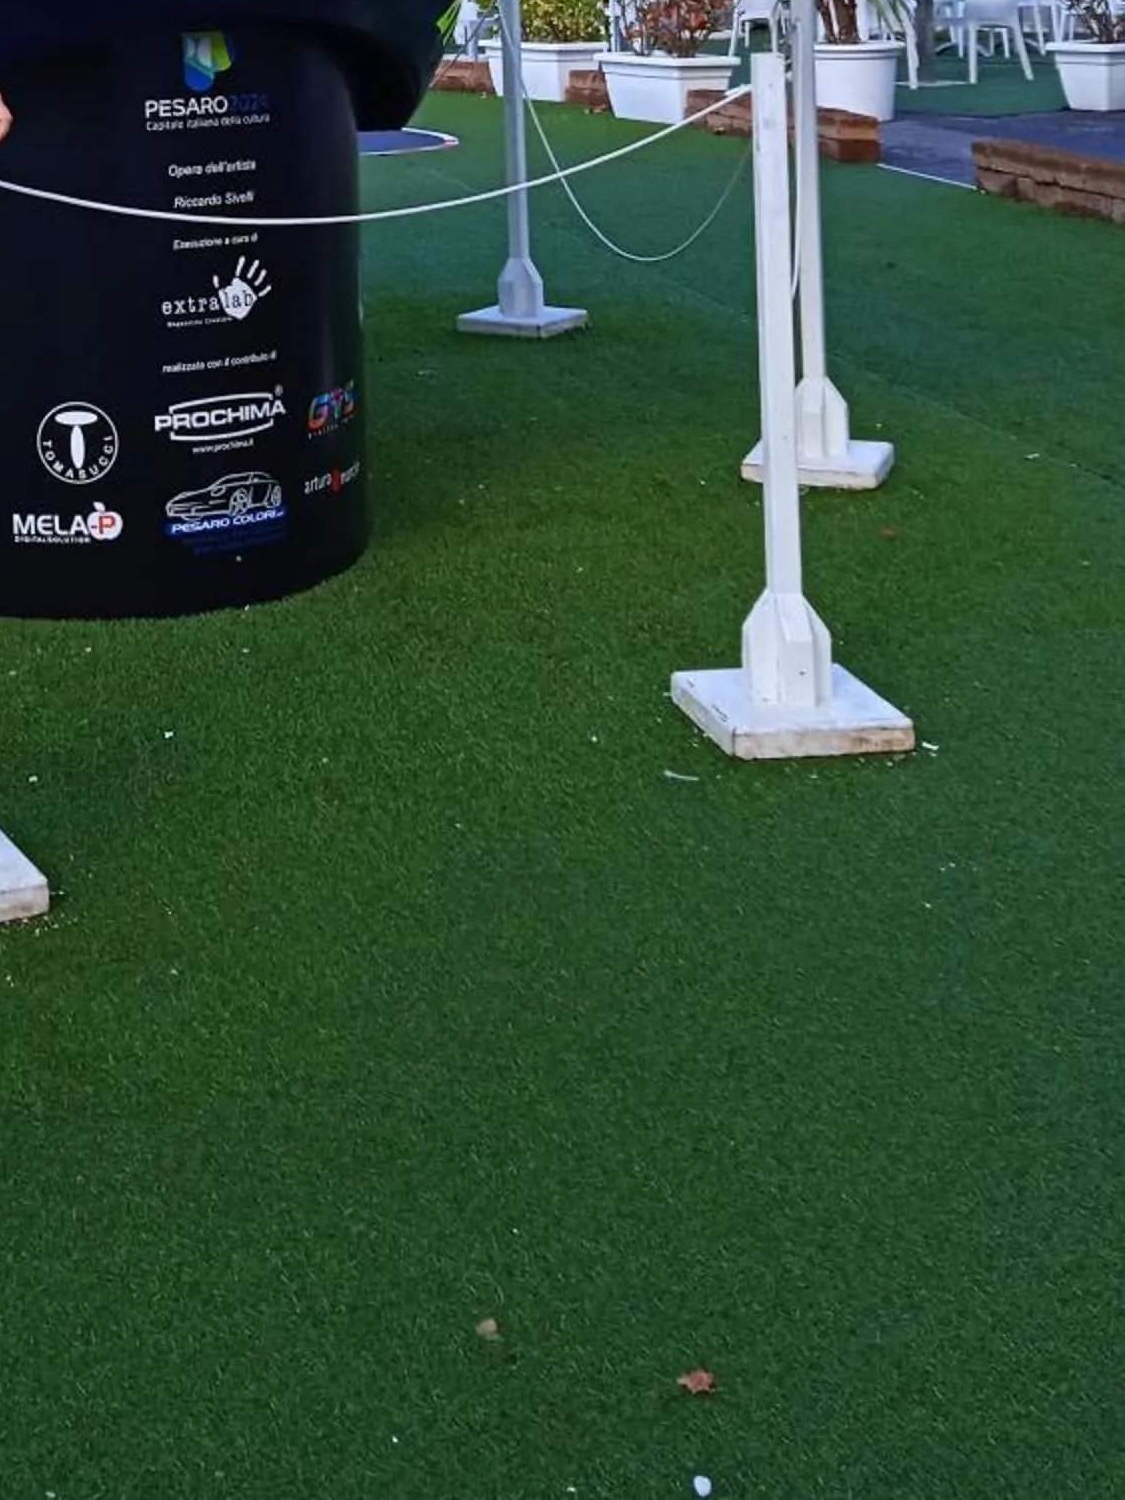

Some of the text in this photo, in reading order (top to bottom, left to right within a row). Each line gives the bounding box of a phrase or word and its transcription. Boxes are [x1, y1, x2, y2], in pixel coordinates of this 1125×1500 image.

[144, 96, 228, 118] PESARO
[146, 119, 184, 131] Capitale
[221, 115, 241, 127] della
[243, 113, 270, 125] cultura
[168, 164, 203, 178] Opera
[174, 194, 222, 208] Riccardo
[154, 399, 286, 431] PROCHIMA
[43, 435, 114, 479] TOMASUCCI
[172, 516, 230, 533] PESARO
